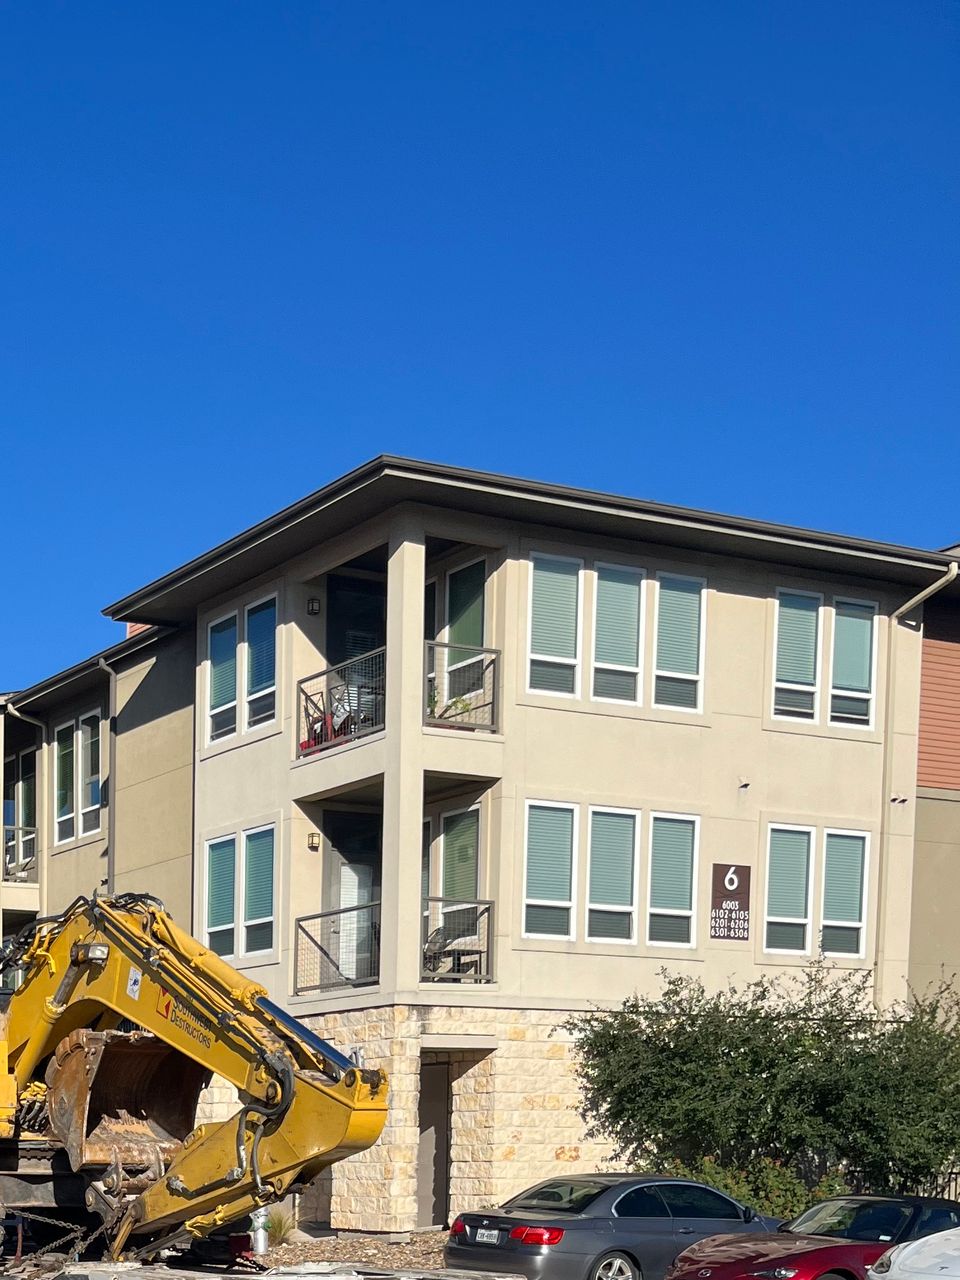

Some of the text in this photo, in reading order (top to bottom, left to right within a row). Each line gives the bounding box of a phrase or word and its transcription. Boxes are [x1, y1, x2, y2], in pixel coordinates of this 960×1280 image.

[724, 866, 739, 891] 6
[722, 901, 739, 910] 6003
[711, 909, 749, 920] 6102-6105
[711, 918, 749, 929] 6201-6206
[710, 927, 748, 938] 6301-6306
[171, 1009, 211, 1049] DESTRUCTORS
